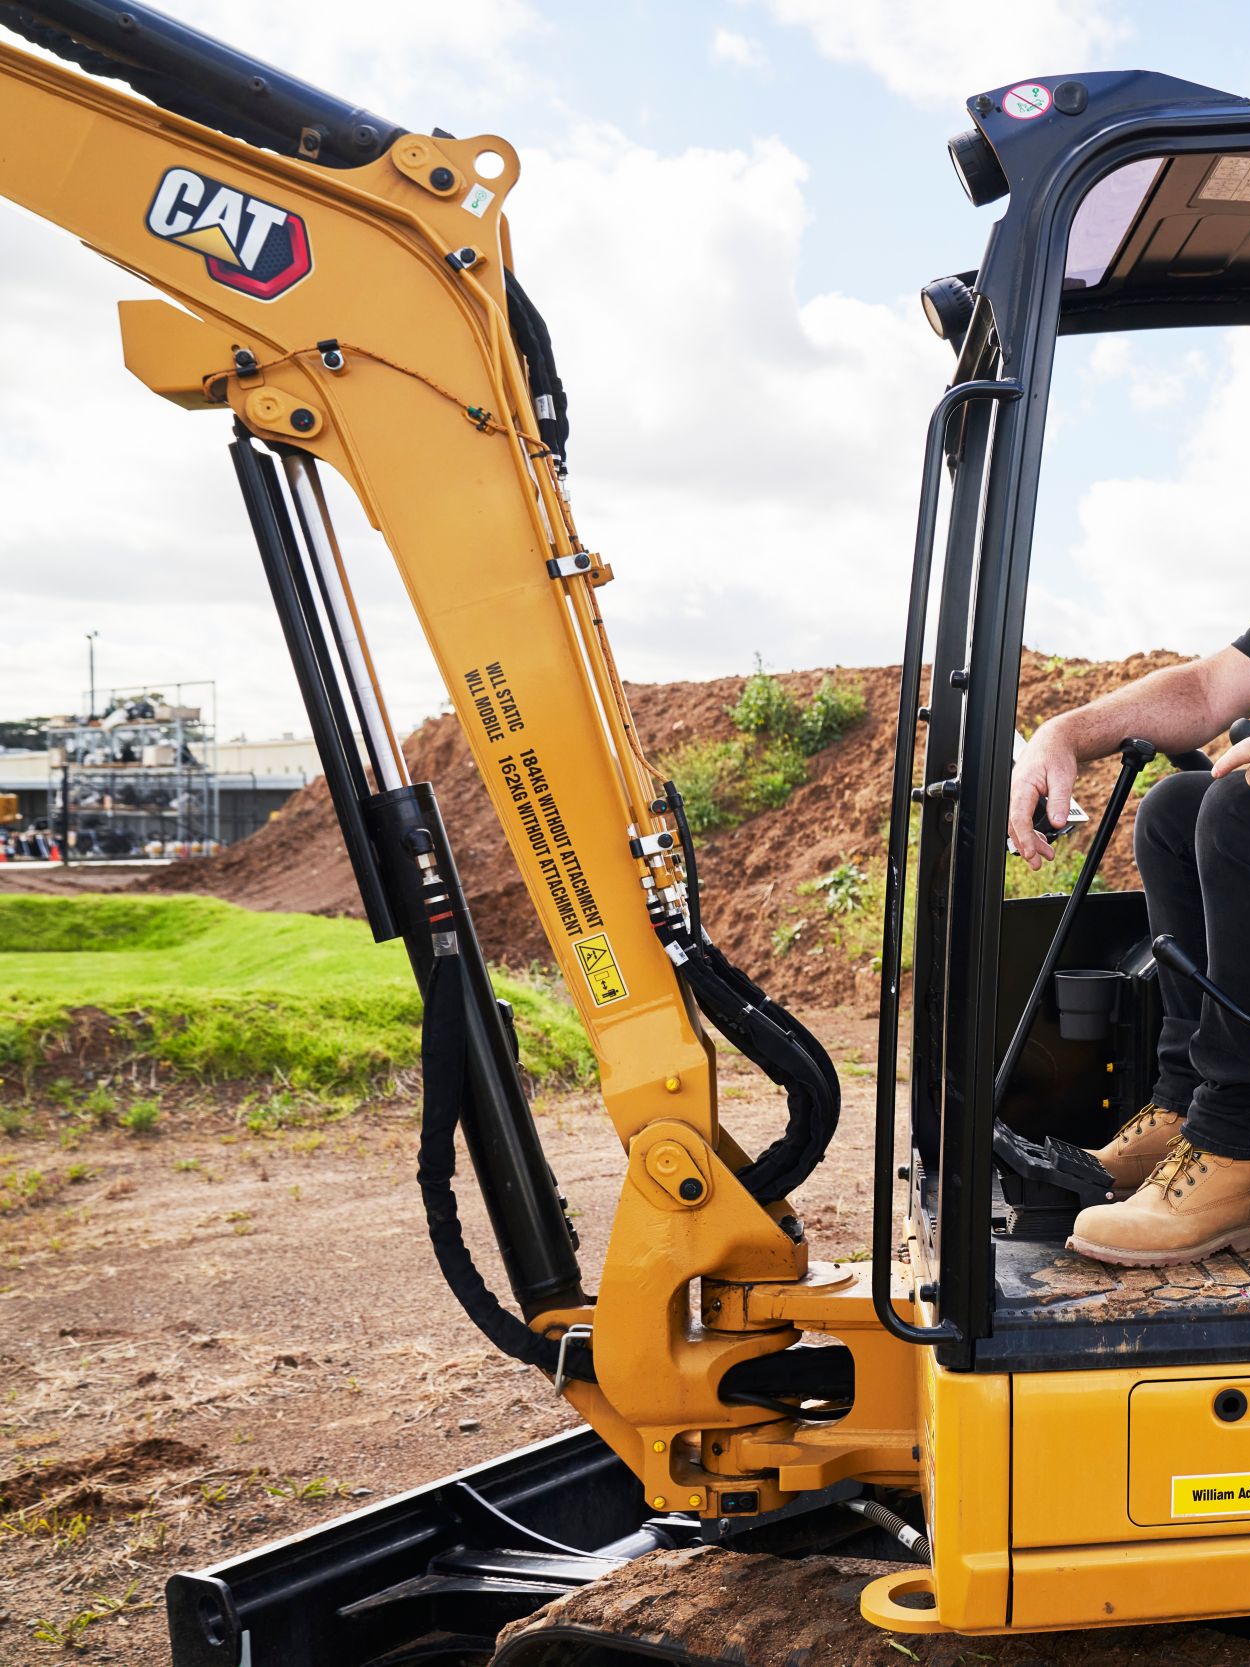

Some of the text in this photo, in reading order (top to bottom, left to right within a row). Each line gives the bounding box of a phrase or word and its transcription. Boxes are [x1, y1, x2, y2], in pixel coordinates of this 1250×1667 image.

[149, 169, 288, 272] CAT
[464, 668, 583, 937] WLL MOBILE 162KG WITHOUT ATTACHMENT
[485, 661, 604, 929] WLL STATIC 184KG WITHOUT ATTACHMENT
[1192, 1488, 1235, 1502] William
